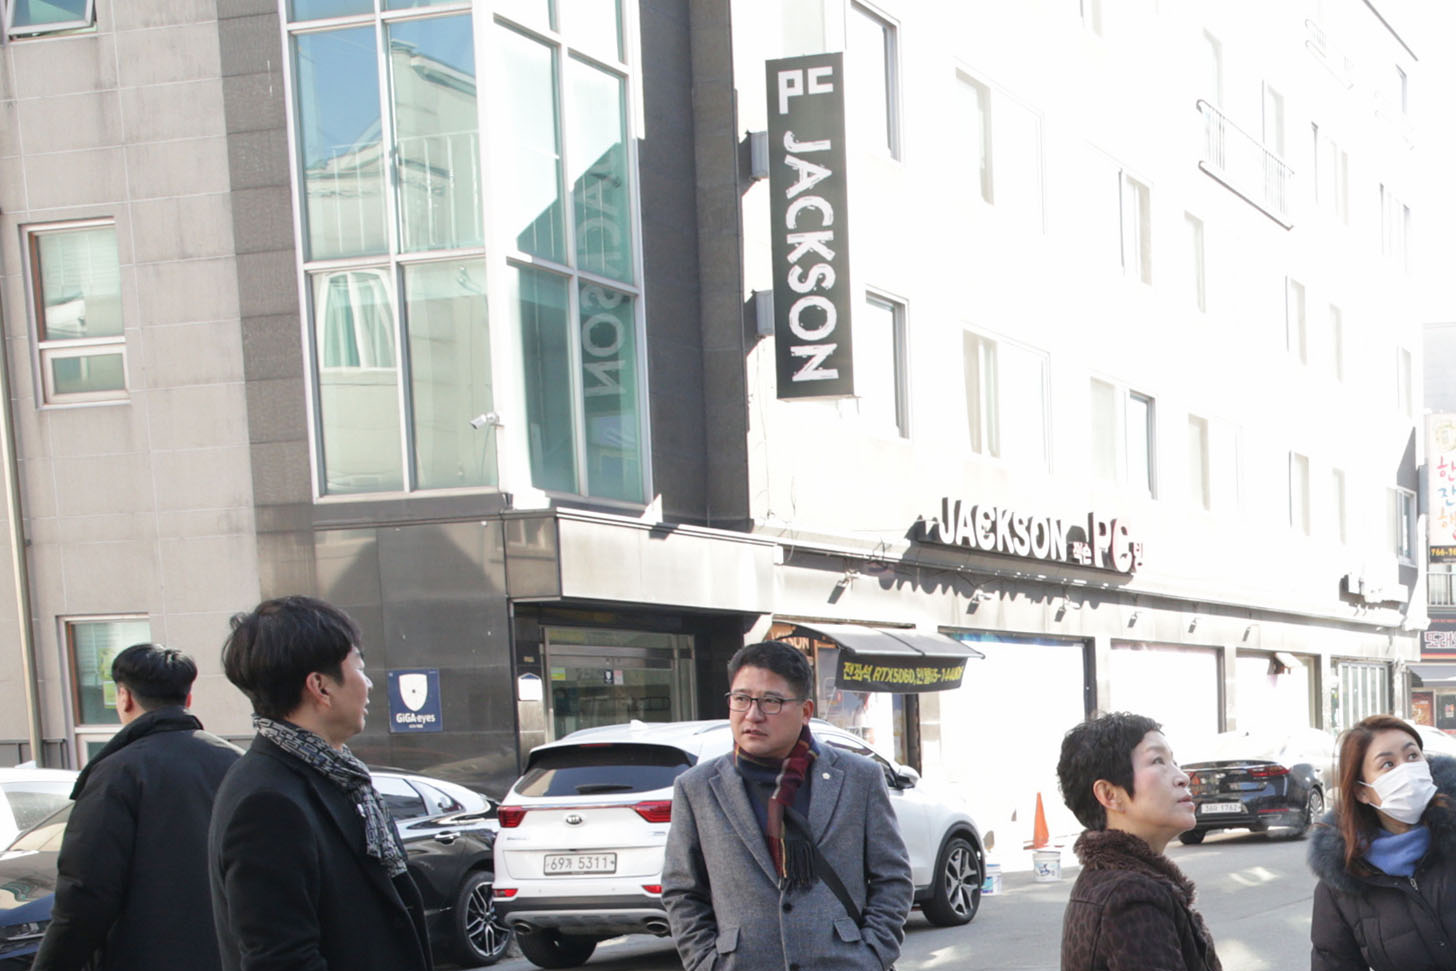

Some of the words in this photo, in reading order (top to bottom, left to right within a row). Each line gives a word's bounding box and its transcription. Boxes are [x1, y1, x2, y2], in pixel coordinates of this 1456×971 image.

[783, 130, 840, 382] JACKSON
[938, 497, 1067, 562] JACKSON
[578, 856, 607, 870] 5311
